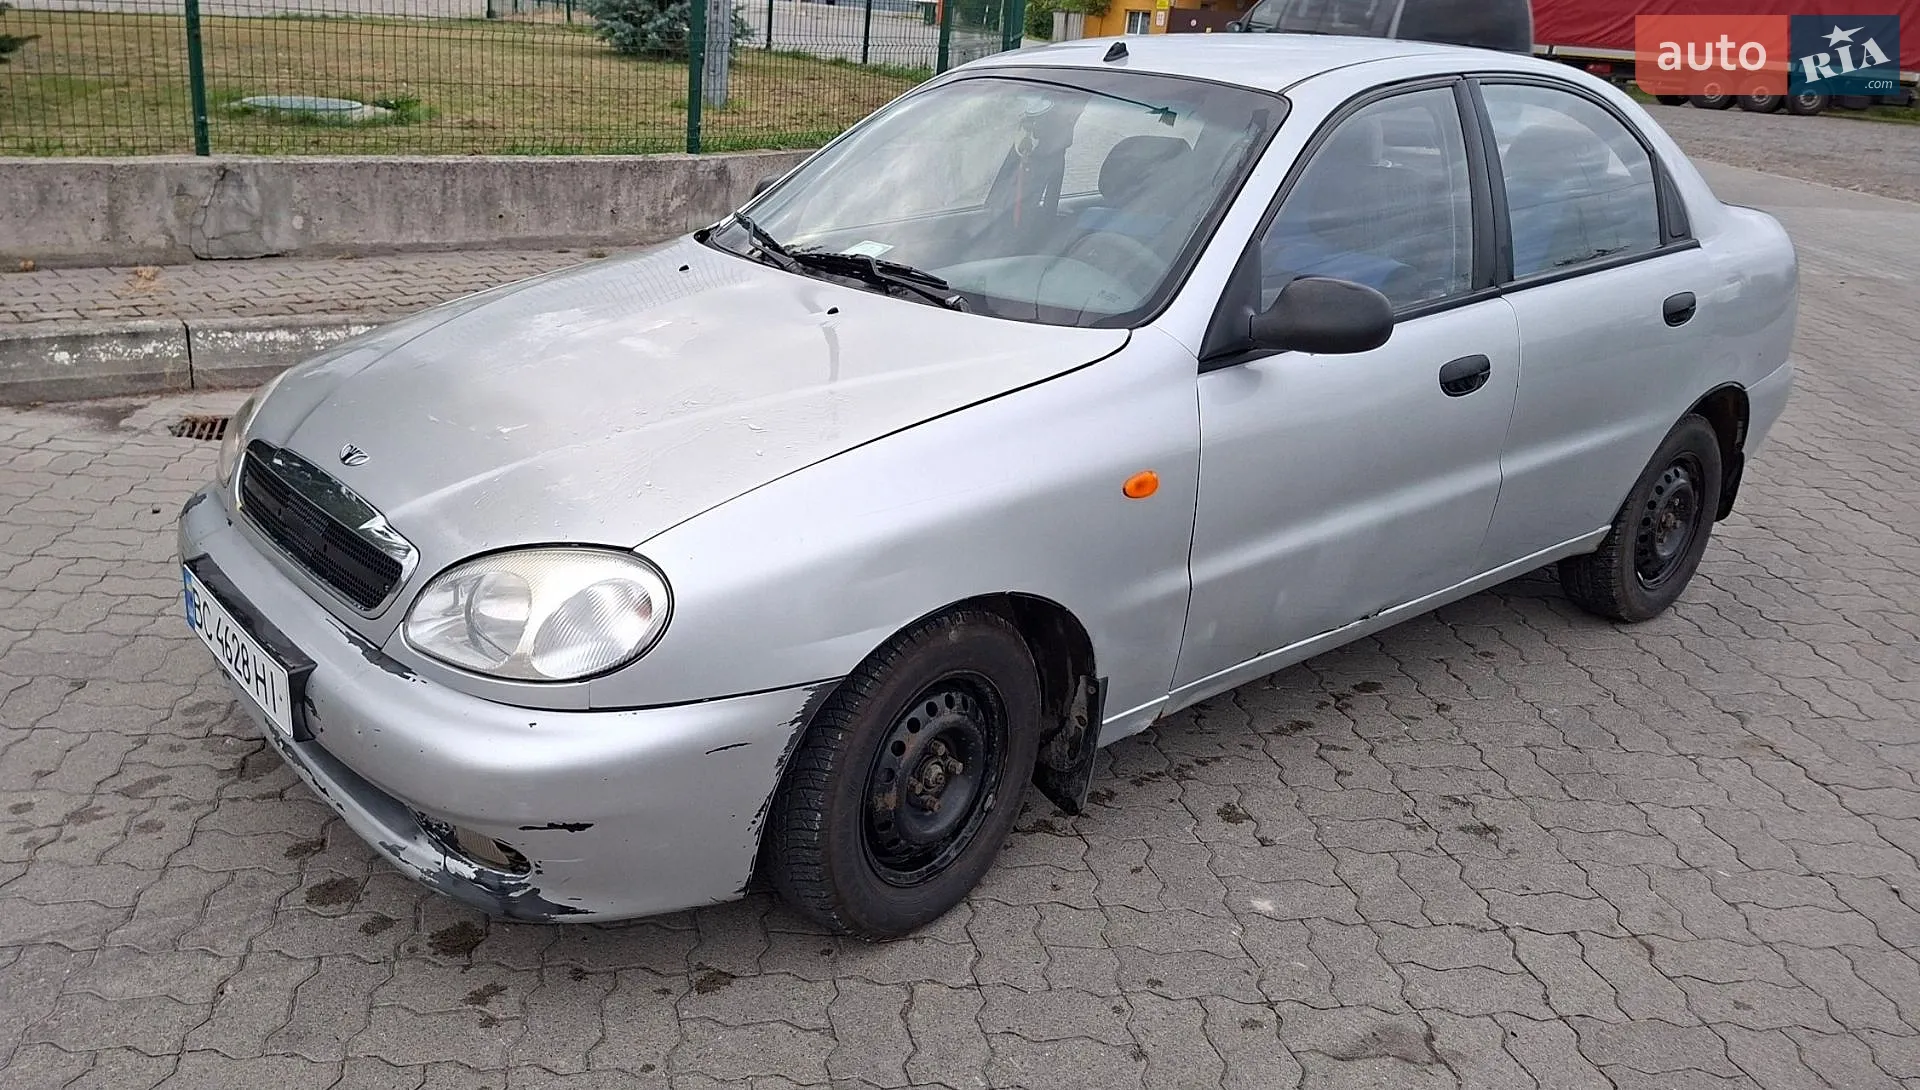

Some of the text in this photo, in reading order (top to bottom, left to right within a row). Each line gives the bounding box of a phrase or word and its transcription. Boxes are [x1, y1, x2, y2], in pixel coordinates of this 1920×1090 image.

[193, 587, 277, 713] BC 4628 HI
